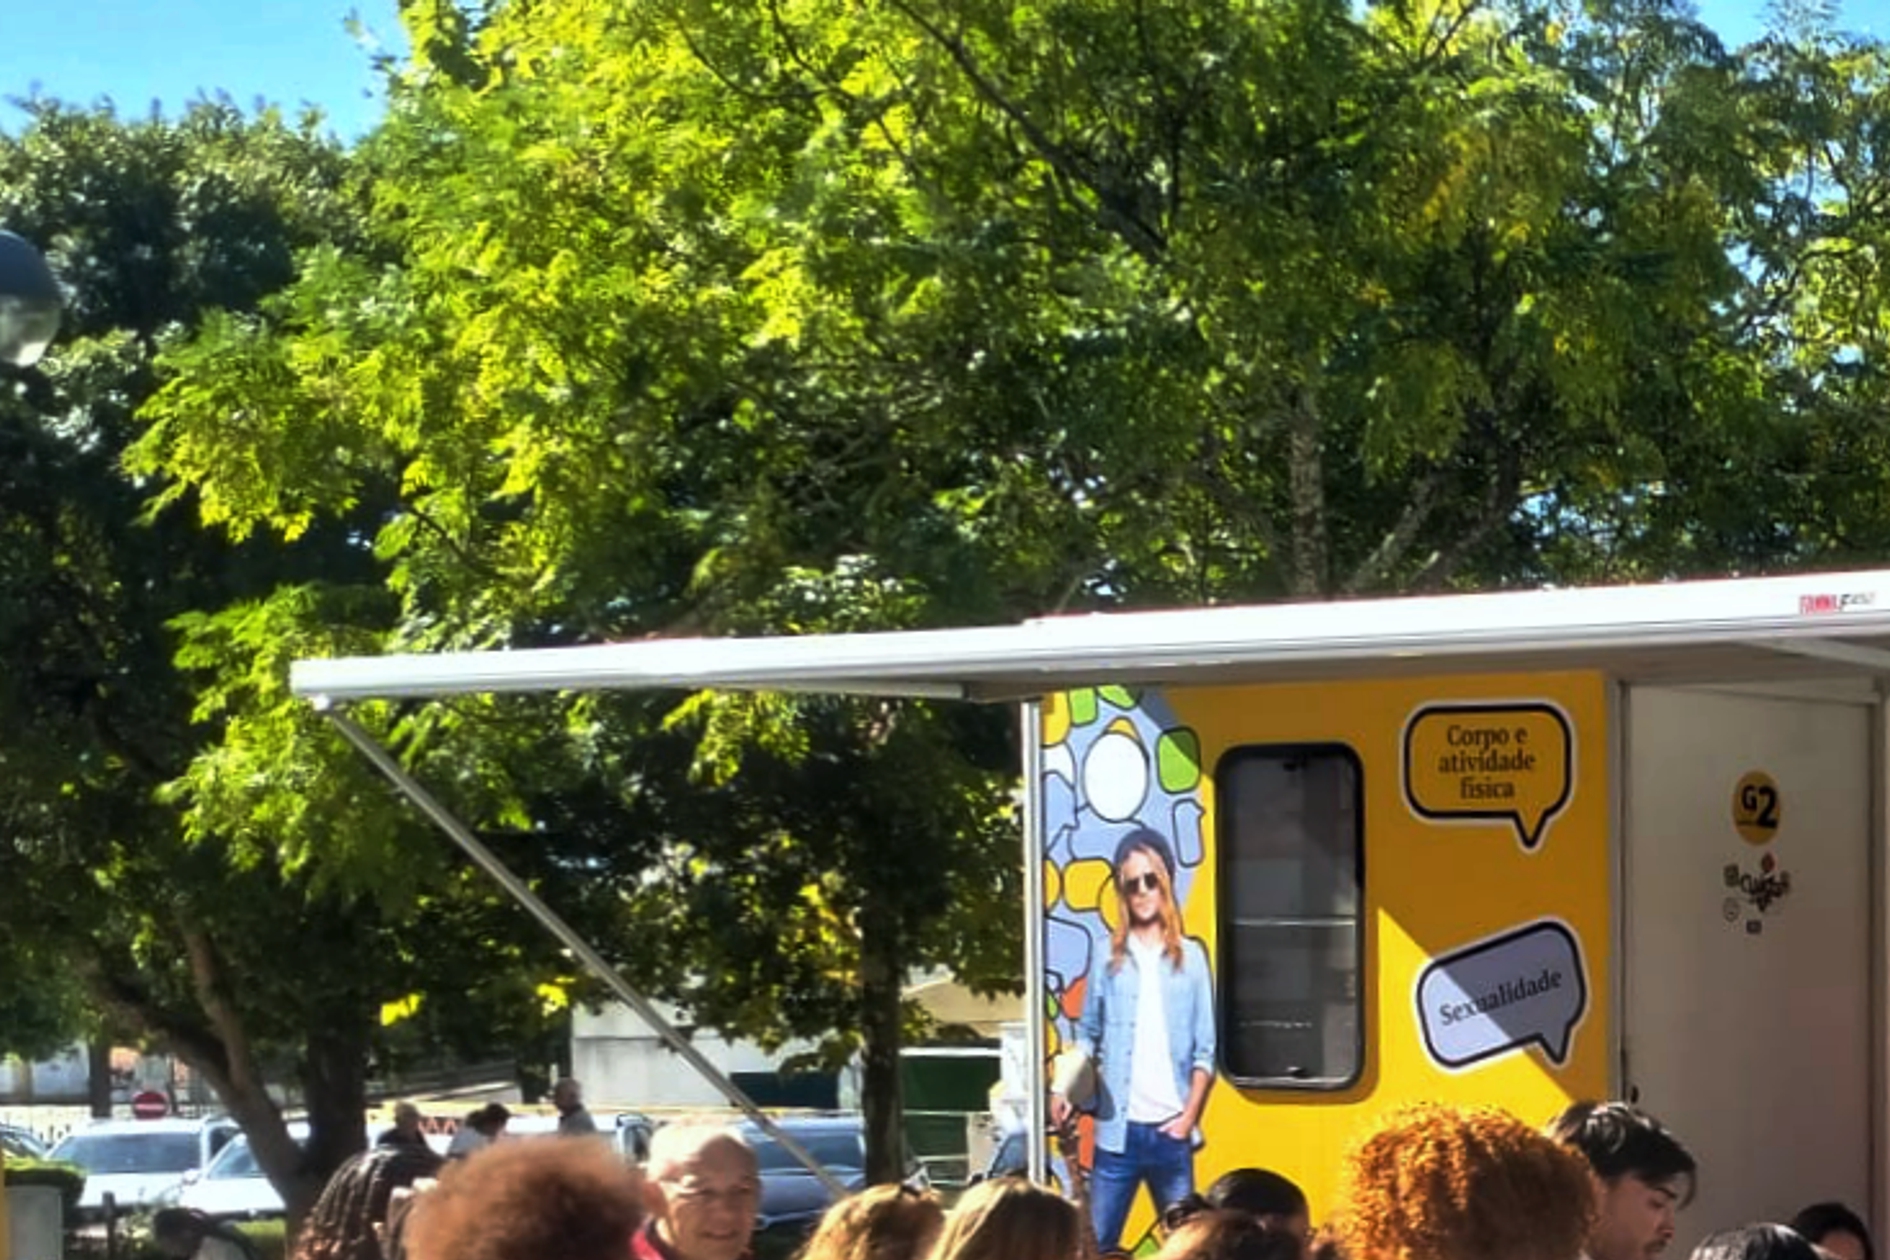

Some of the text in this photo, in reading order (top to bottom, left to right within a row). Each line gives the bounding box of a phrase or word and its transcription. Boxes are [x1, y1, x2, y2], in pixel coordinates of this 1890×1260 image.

[1446, 724, 1529, 750] Corpo e
[1437, 750, 1536, 774] atividade
[1439, 969, 1563, 1026] Sexualidade
